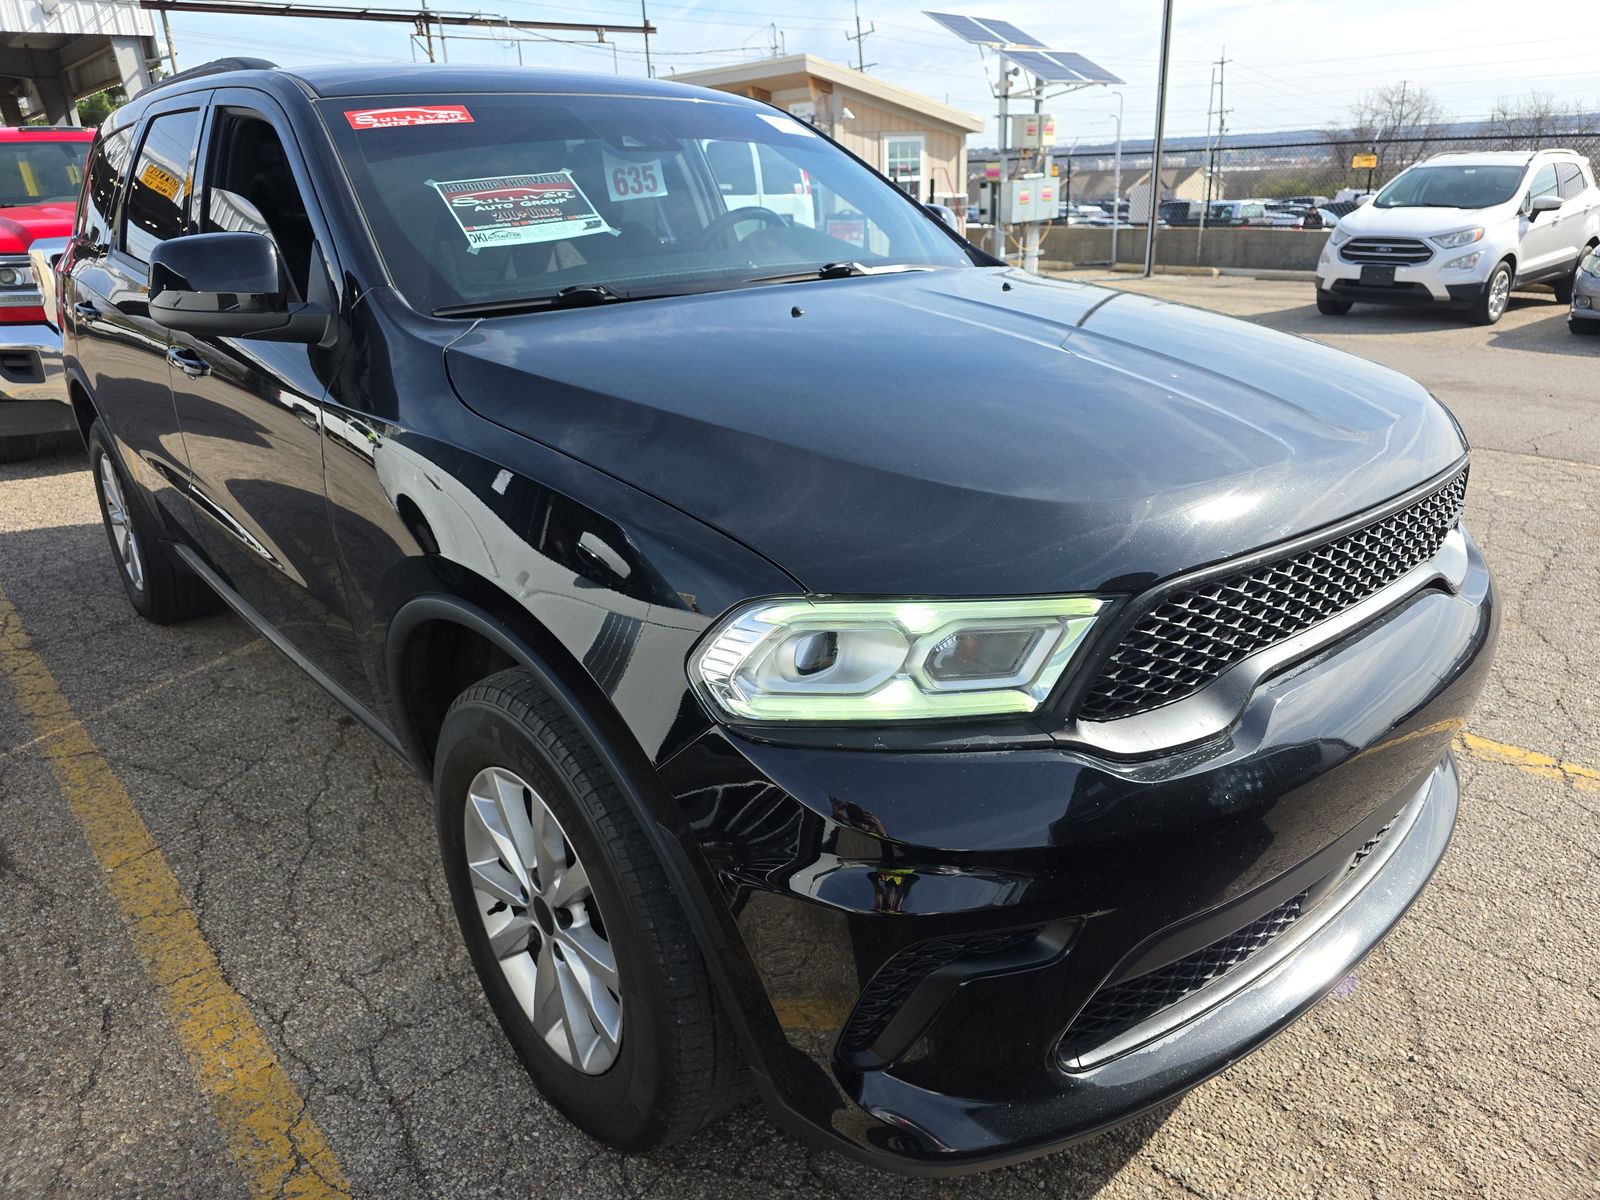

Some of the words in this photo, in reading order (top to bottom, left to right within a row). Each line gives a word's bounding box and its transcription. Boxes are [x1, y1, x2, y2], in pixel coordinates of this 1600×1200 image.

[612, 164, 658, 197] 635
[474, 203, 514, 212] AUTO
[520, 198, 568, 207] GROUP
